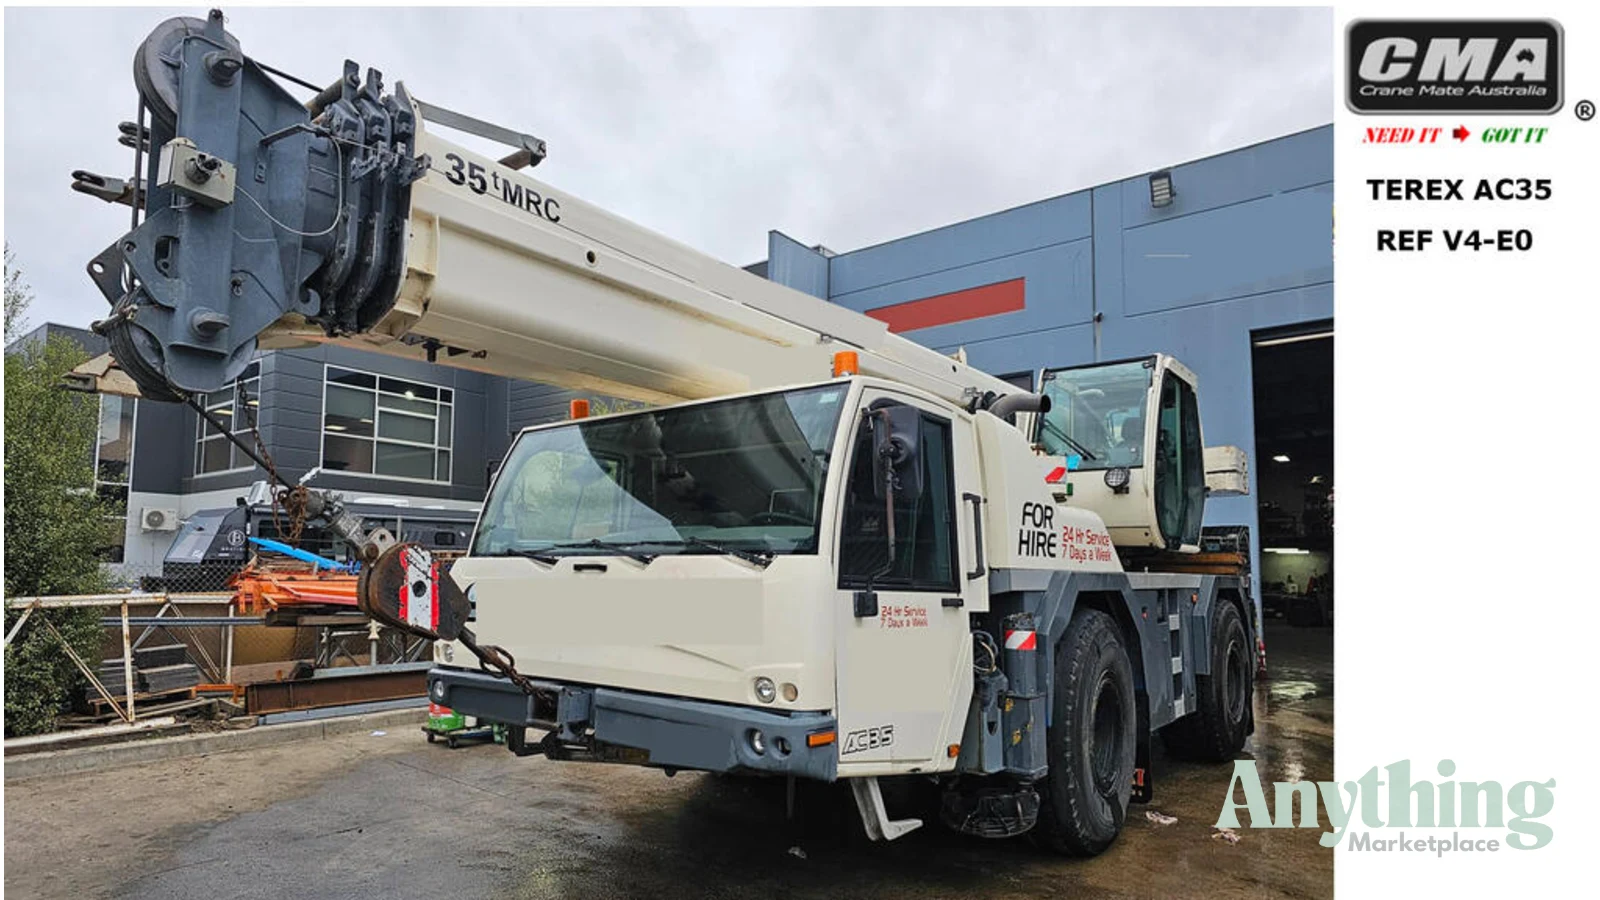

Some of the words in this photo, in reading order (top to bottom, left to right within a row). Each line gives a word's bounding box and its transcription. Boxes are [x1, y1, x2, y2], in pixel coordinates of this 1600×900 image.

[501, 177, 561, 224] MRC
[1022, 502, 1053, 529] FOR
[1018, 529, 1057, 558] HIRE
[1062, 526, 1074, 542] 24
[1075, 528, 1084, 544] Hr
[1086, 529, 1109, 546] Service
[1062, 543, 1067, 559] 7
[1069, 544, 1086, 563] Days
[1089, 549, 1094, 560] a
[1095, 547, 1111, 561] Week
[881, 605, 892, 616] 24
[841, 725, 894, 755] AC35
